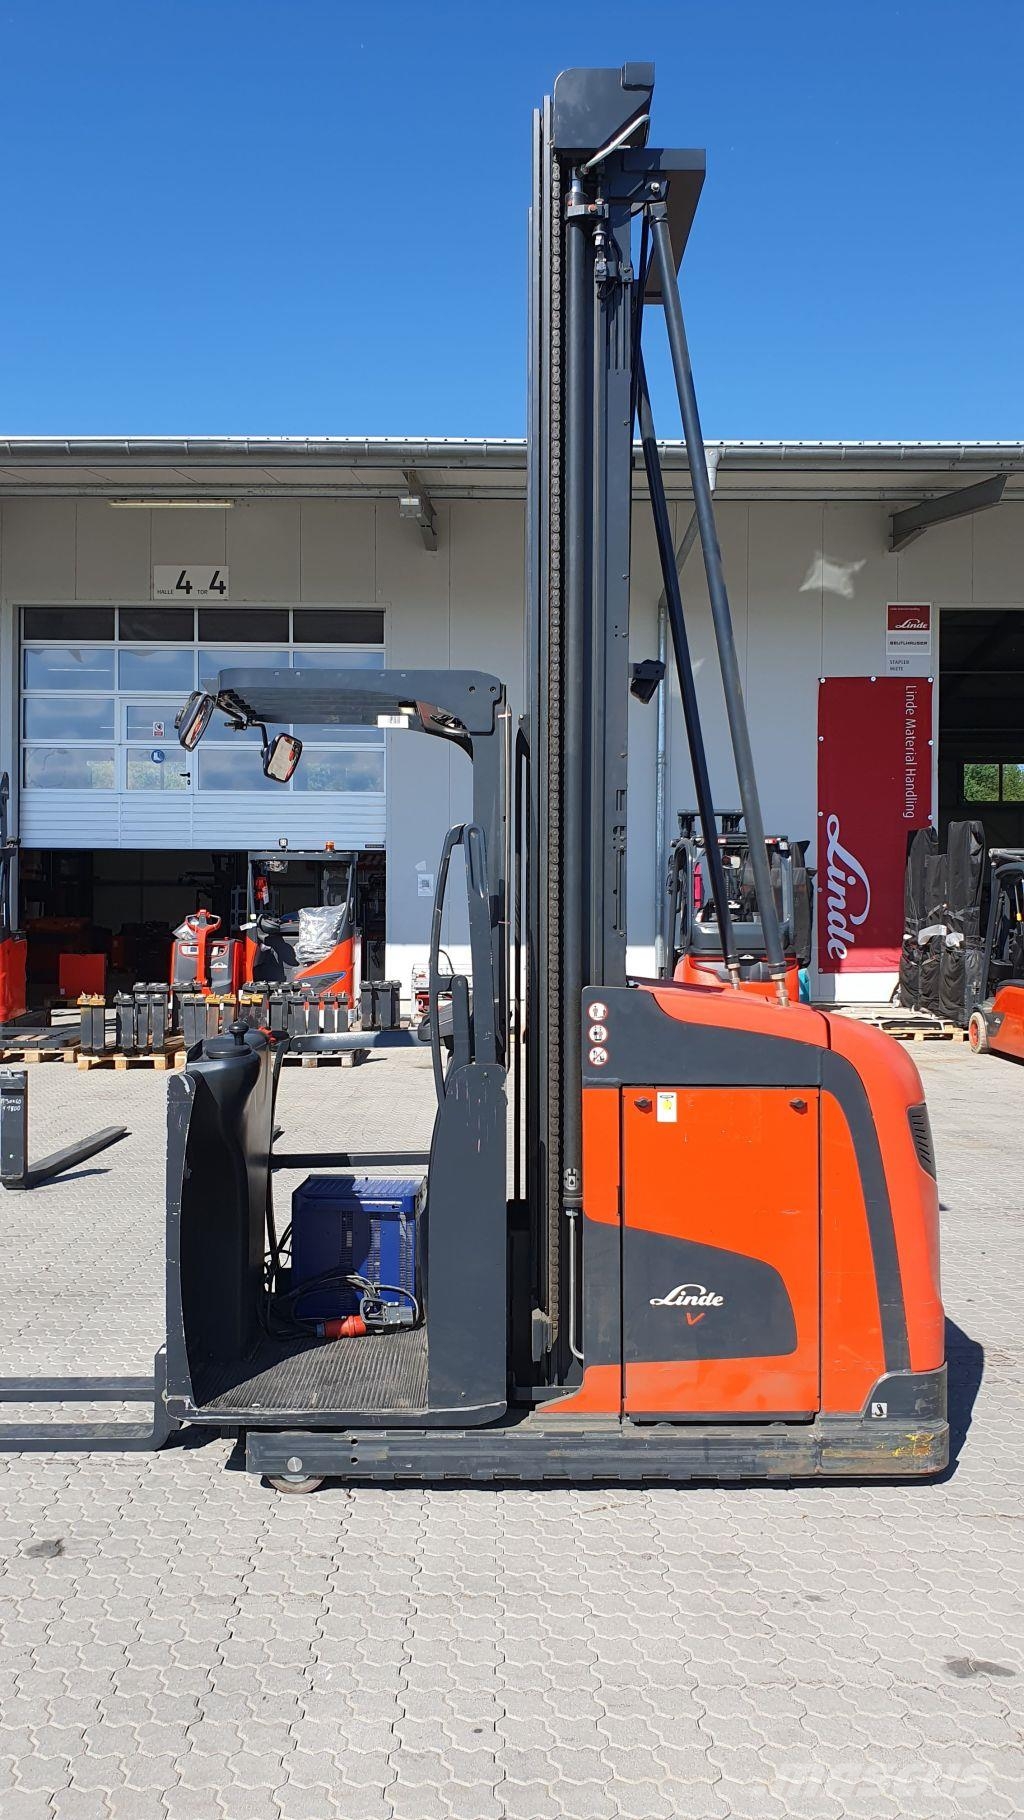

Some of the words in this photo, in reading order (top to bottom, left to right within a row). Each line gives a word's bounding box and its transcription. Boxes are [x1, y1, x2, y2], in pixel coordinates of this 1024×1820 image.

[176, 570, 193, 594] 4
[209, 570, 226, 594] 4
[895, 618, 928, 628] Linde
[905, 685, 918, 715] Linde
[905, 718, 918, 765] Material
[902, 768, 918, 819] Handling
[826, 814, 871, 960] Linde
[649, 1283, 724, 1307] Linde
